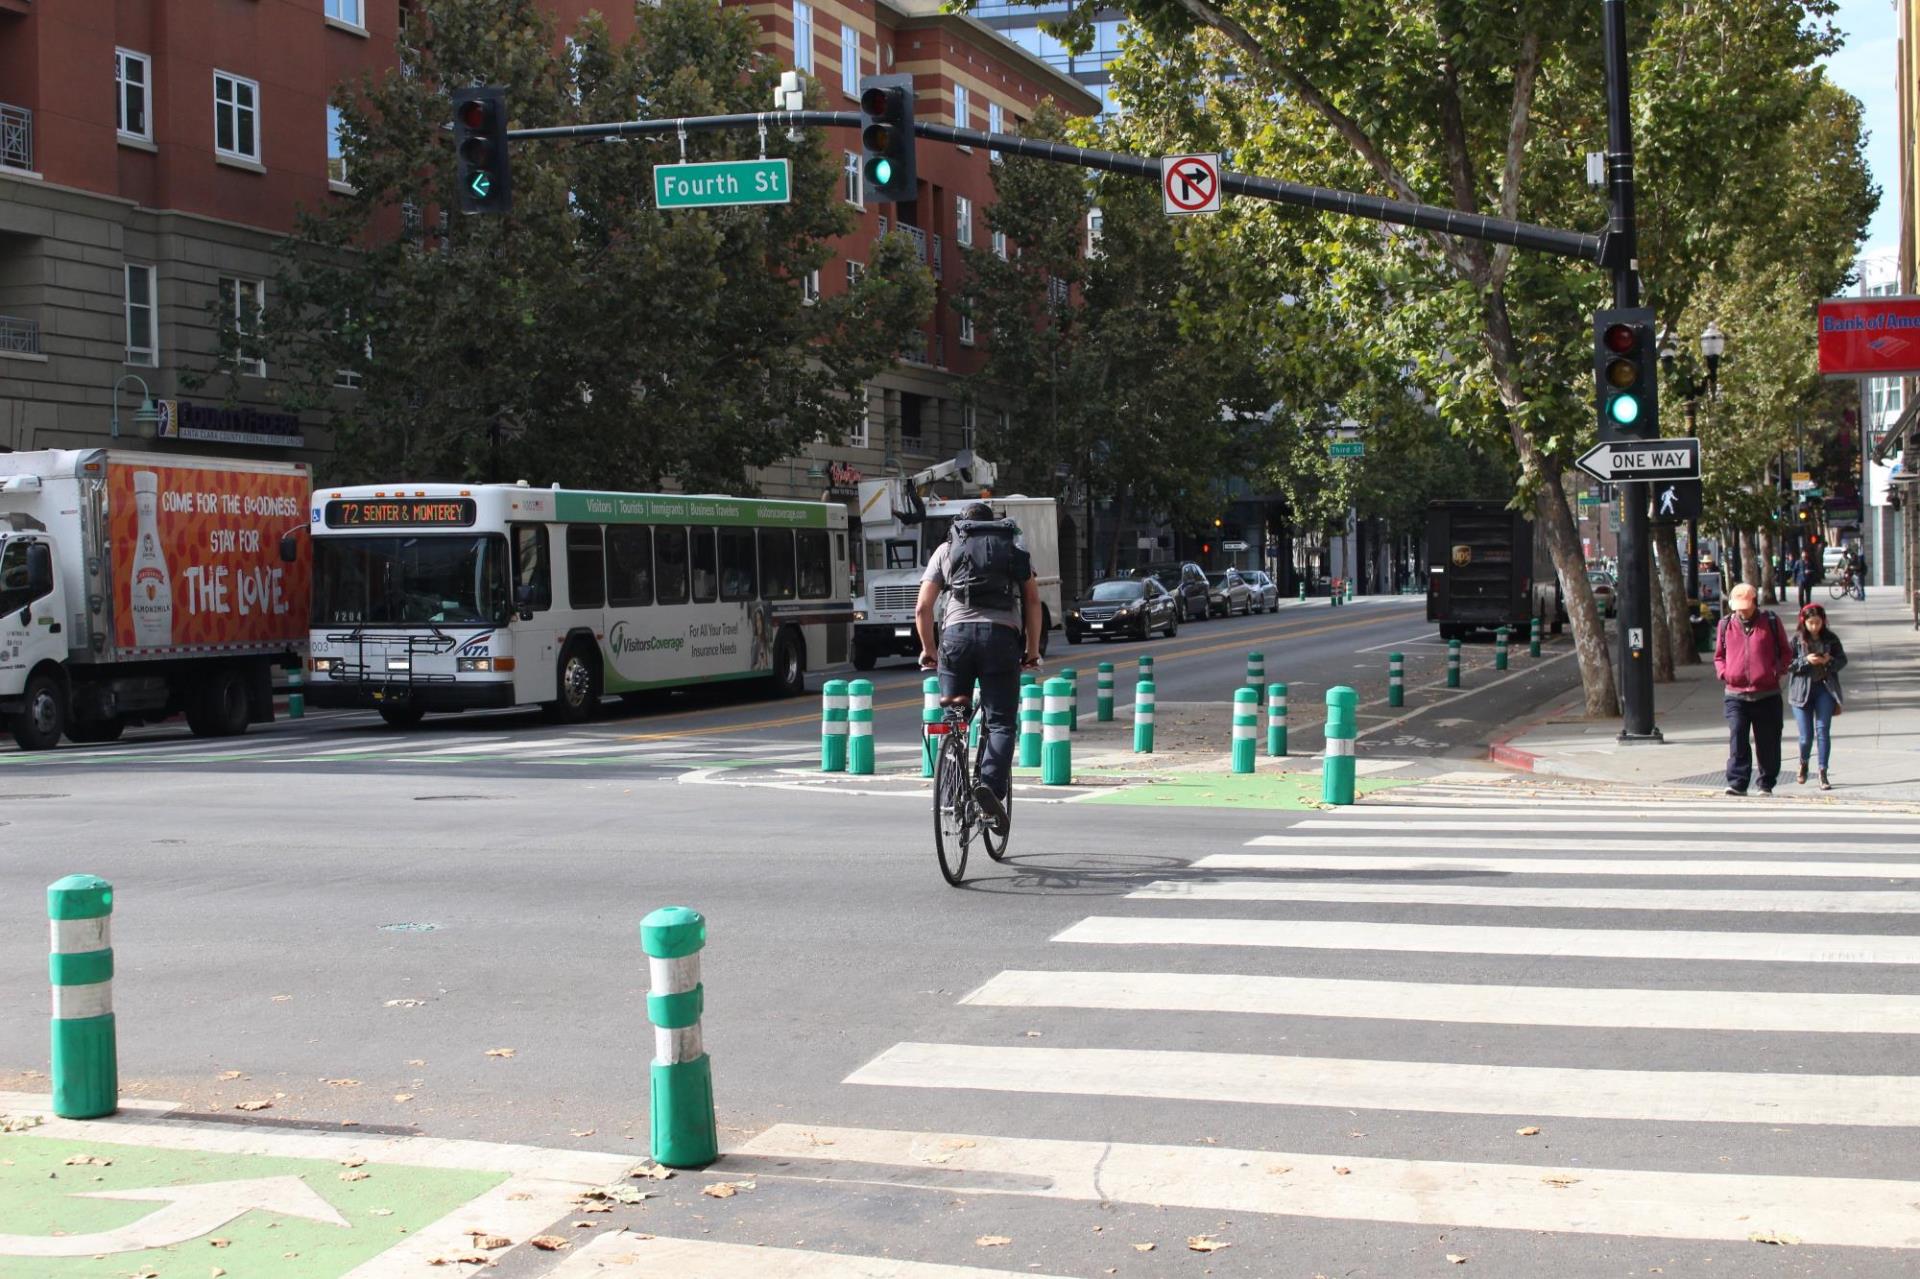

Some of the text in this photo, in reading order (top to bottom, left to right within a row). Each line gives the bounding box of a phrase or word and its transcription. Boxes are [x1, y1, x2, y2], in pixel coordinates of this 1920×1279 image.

[663, 171, 779, 197] Fourth St
[1823, 315, 1865, 332] Bank
[1868, 313, 1885, 329] of
[1331, 446, 1350, 454] Third
[1613, 452, 1685, 468] ONE WAY
[162, 491, 194, 513] COME
[197, 492, 217, 514] FOR
[221, 494, 241, 514] THE
[586, 498, 739, 518] Visitors Tourists Immigrants Business Travelers
[341, 504, 463, 524] 72 SENTER & MONTEREY
[210, 529, 259, 553] STAY FOR
[183, 565, 230, 615] THE
[689, 624, 699, 638] For
[709, 623, 721, 636] Your
[722, 621, 738, 635] Travel
[463, 645, 490, 657] VTA
[623, 636, 684, 653] VisitorsCoverage
[692, 642, 737, 657] Insurance Needs
